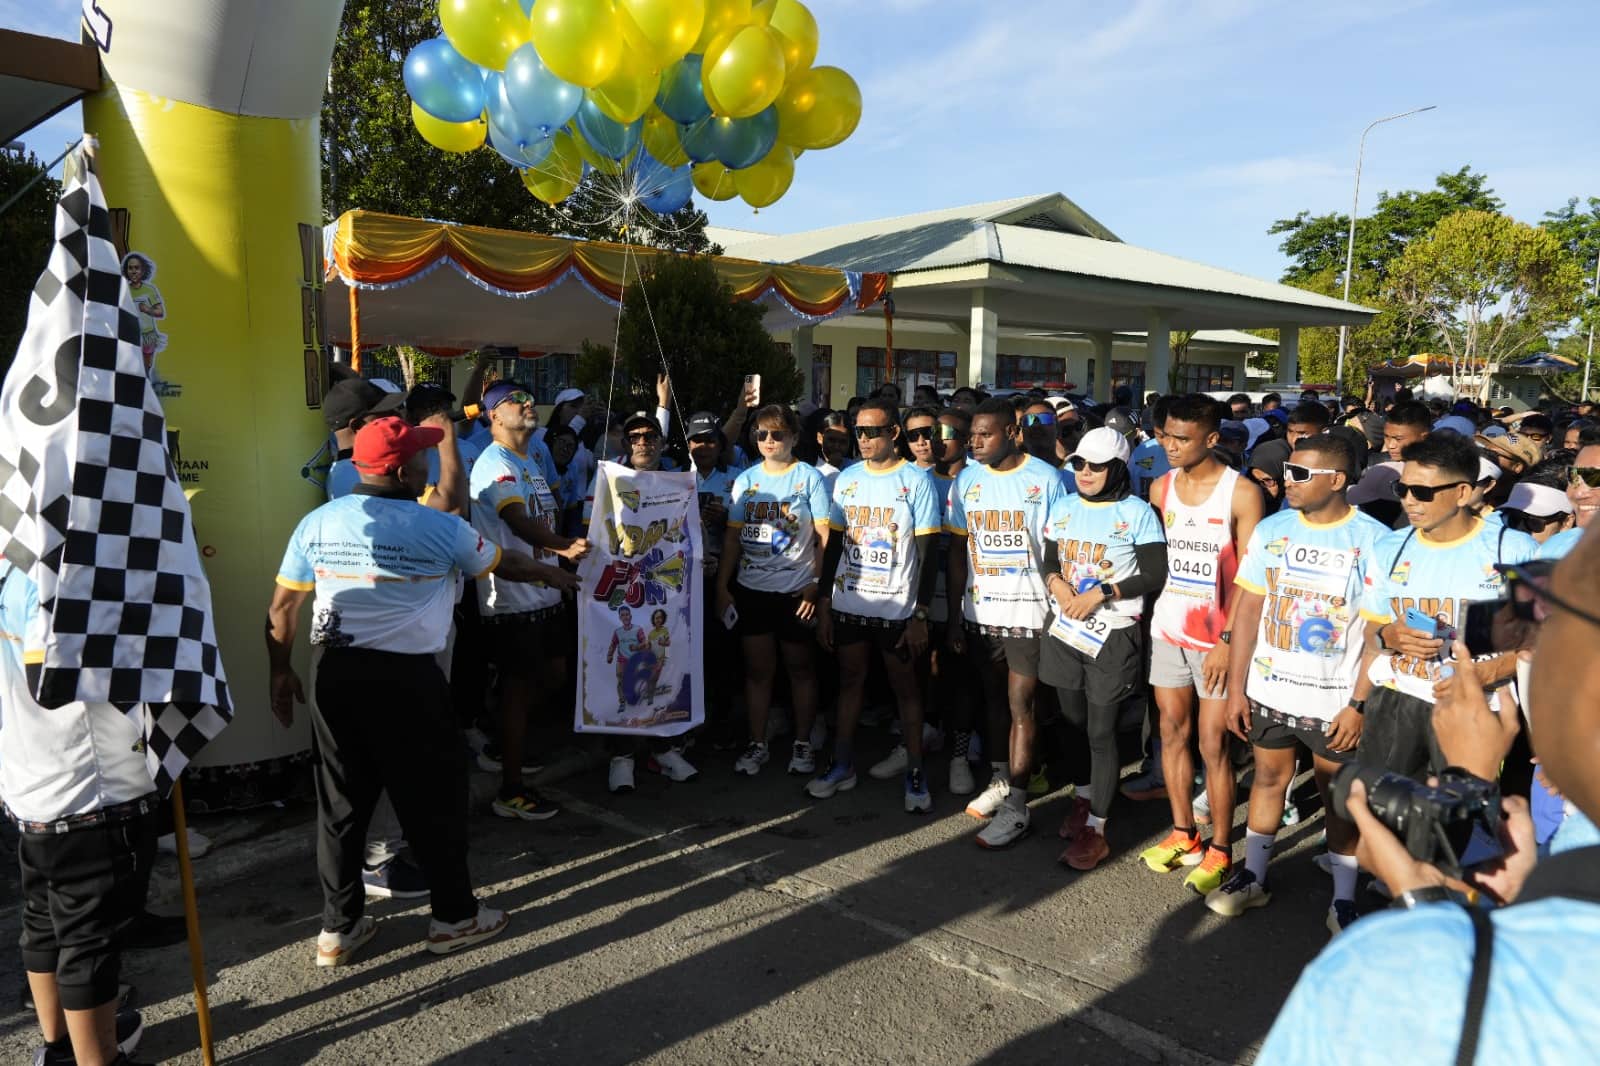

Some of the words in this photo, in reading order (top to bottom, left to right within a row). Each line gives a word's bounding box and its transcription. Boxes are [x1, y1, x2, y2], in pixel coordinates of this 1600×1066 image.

[743, 526, 769, 539] 0666
[983, 534, 1024, 548] 0658
[1295, 547, 1346, 570] 0326
[1173, 558, 1213, 577] 0440
